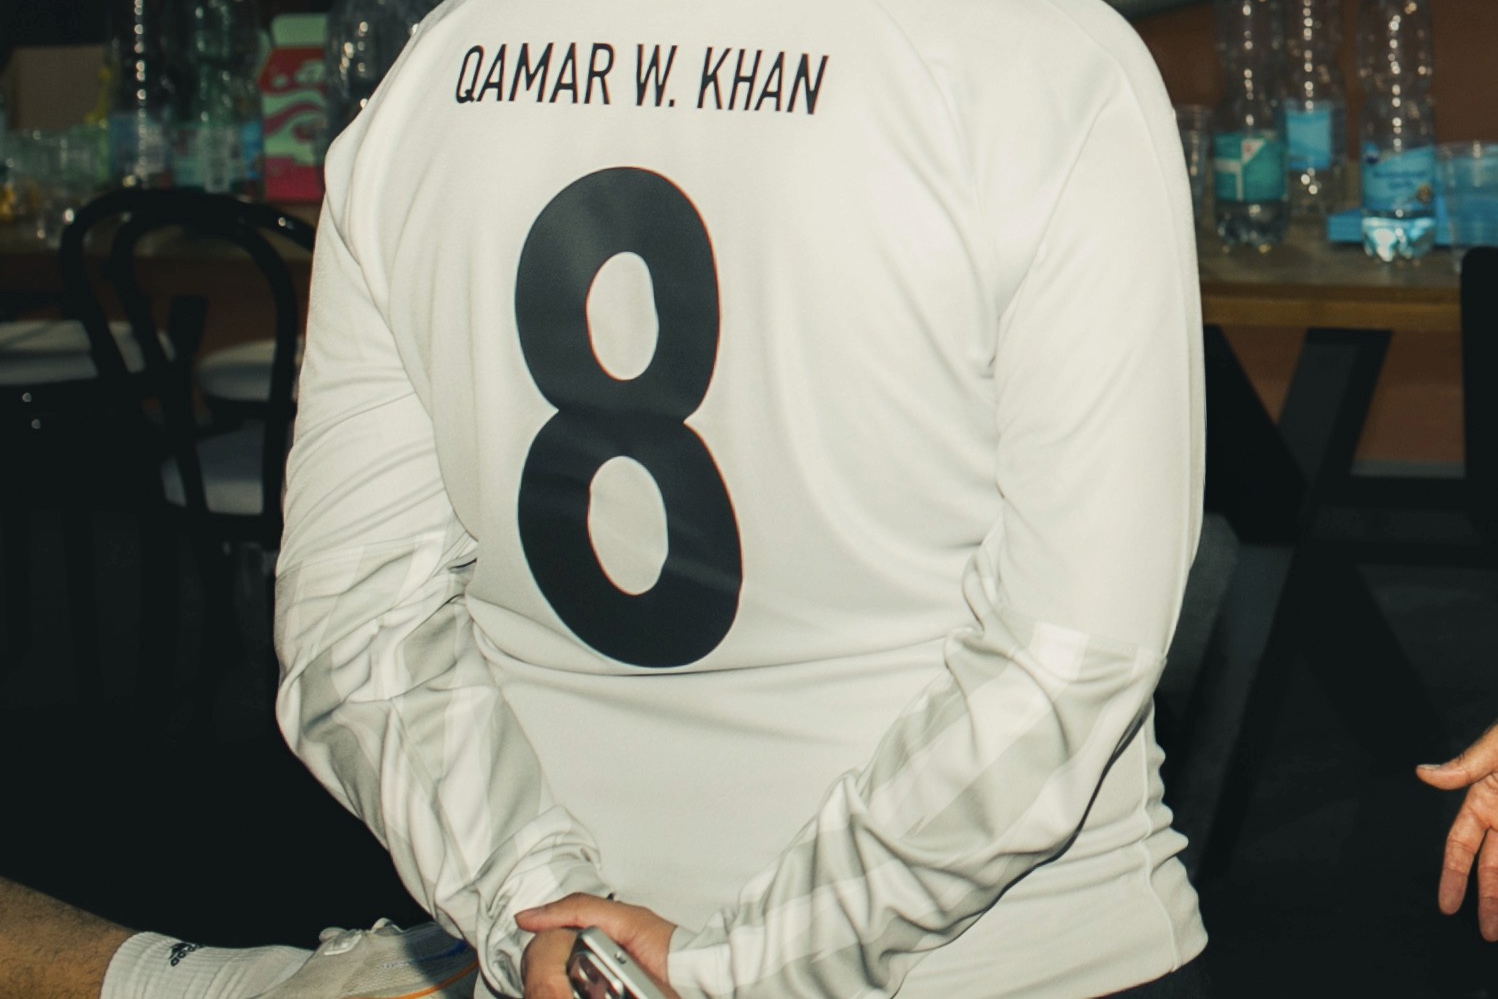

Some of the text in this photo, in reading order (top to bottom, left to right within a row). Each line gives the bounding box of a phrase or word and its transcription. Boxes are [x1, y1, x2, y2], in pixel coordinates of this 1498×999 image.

[456, 43, 829, 115] QAMAR W. KHAN
[514, 166, 744, 669] 8
